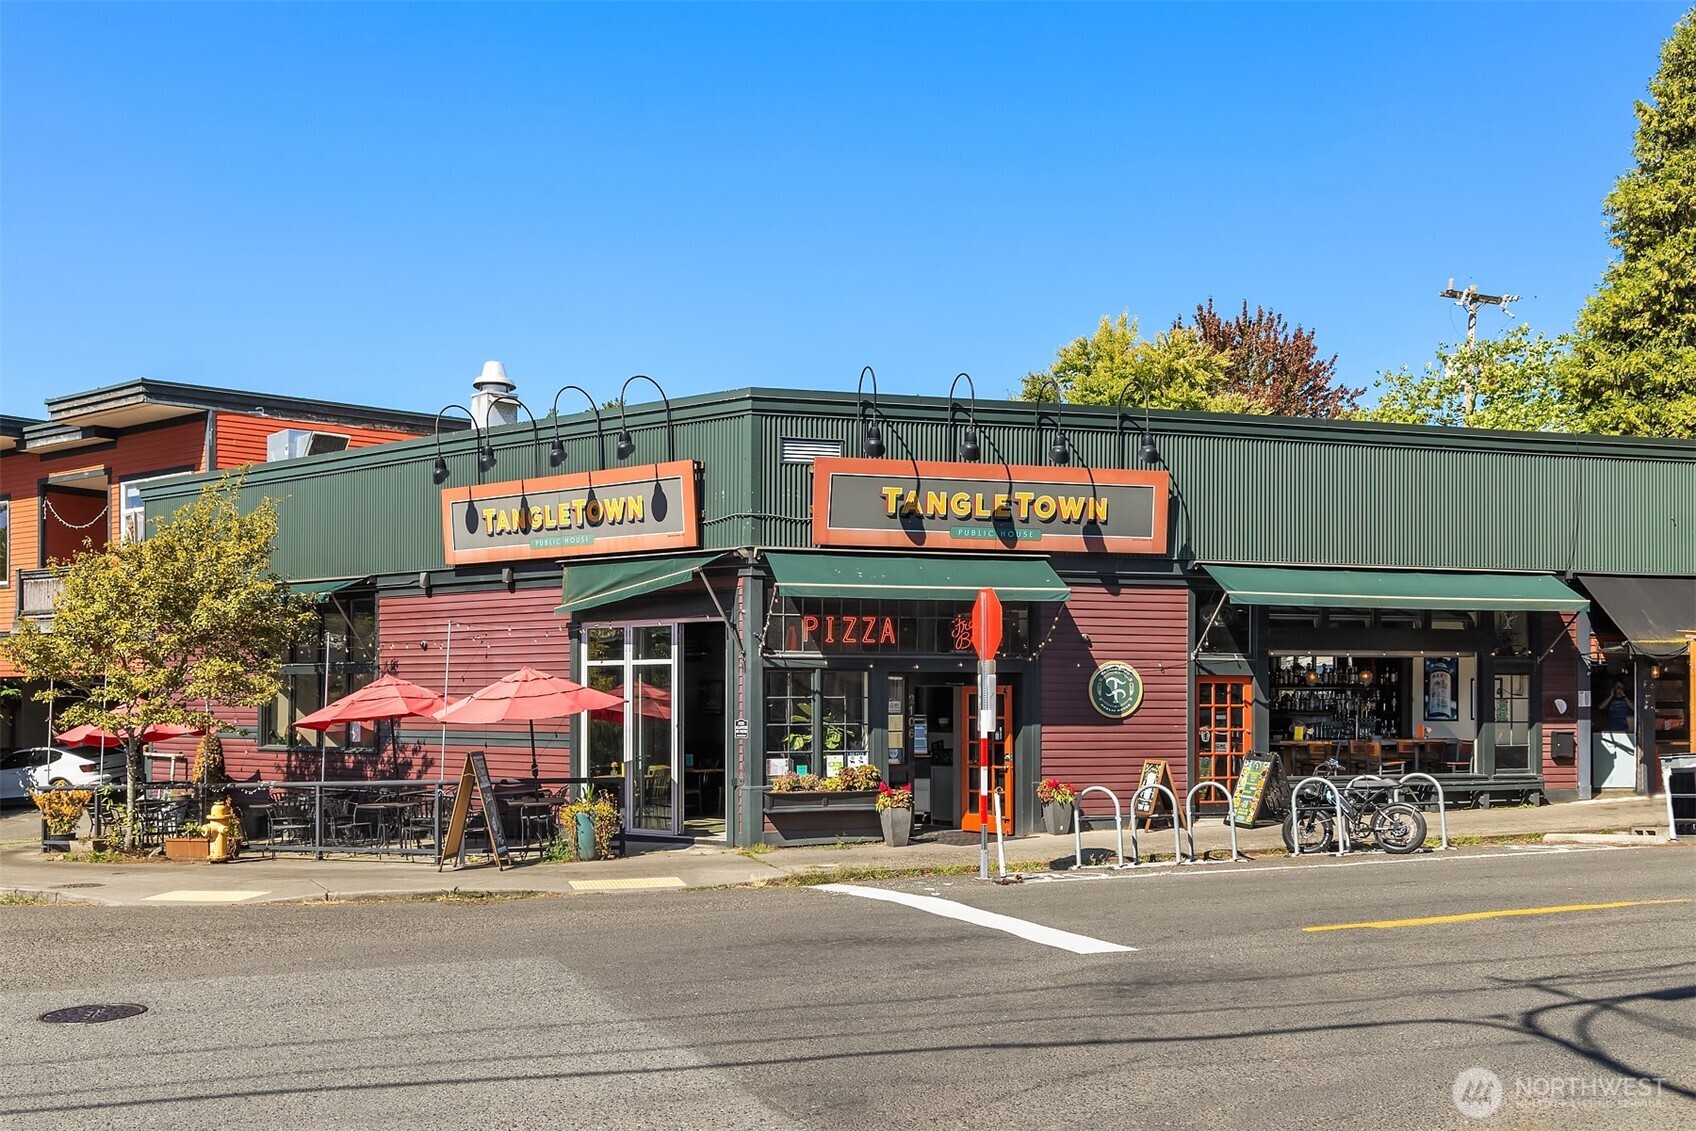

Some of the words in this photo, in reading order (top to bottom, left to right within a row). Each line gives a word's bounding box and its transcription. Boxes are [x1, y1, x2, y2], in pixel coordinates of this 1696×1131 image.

[482, 495, 645, 537] TANGLETOWN
[881, 486, 1108, 524] TANGLETOWN
[535, 538, 561, 546] PUBLIC
[564, 535, 590, 545] HOUSE
[957, 529, 995, 538] PUBLIC
[1000, 530, 1034, 539] HOUSE
[803, 616, 895, 643] PIZZA
